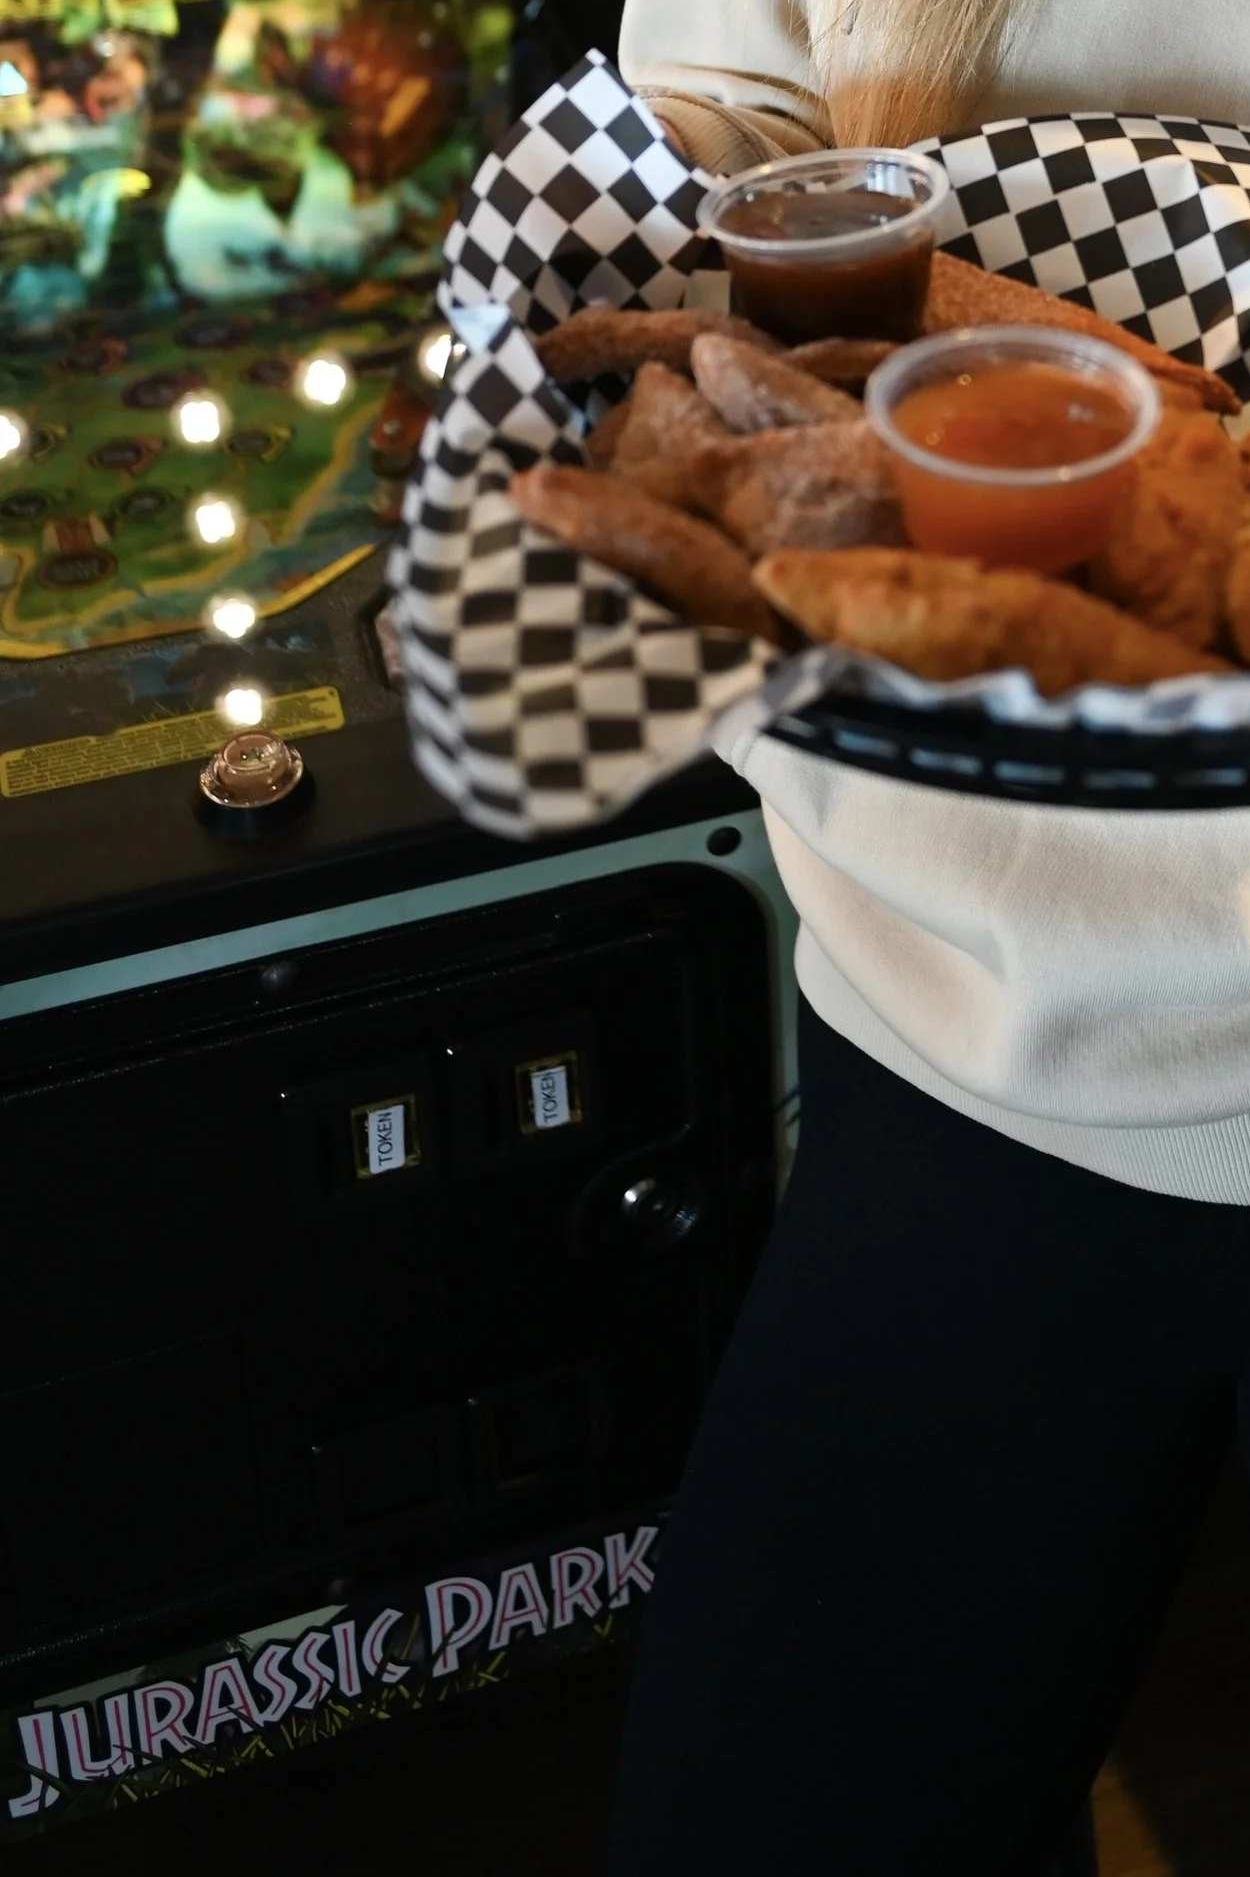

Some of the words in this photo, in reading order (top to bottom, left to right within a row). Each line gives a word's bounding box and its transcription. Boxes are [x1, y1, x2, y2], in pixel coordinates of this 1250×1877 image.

[540, 1072, 558, 1122] TOKEN
[377, 1111, 393, 1167] TOKEN
[9, 1608, 410, 1818] JURASSIC
[425, 1526, 659, 1678] PARK
